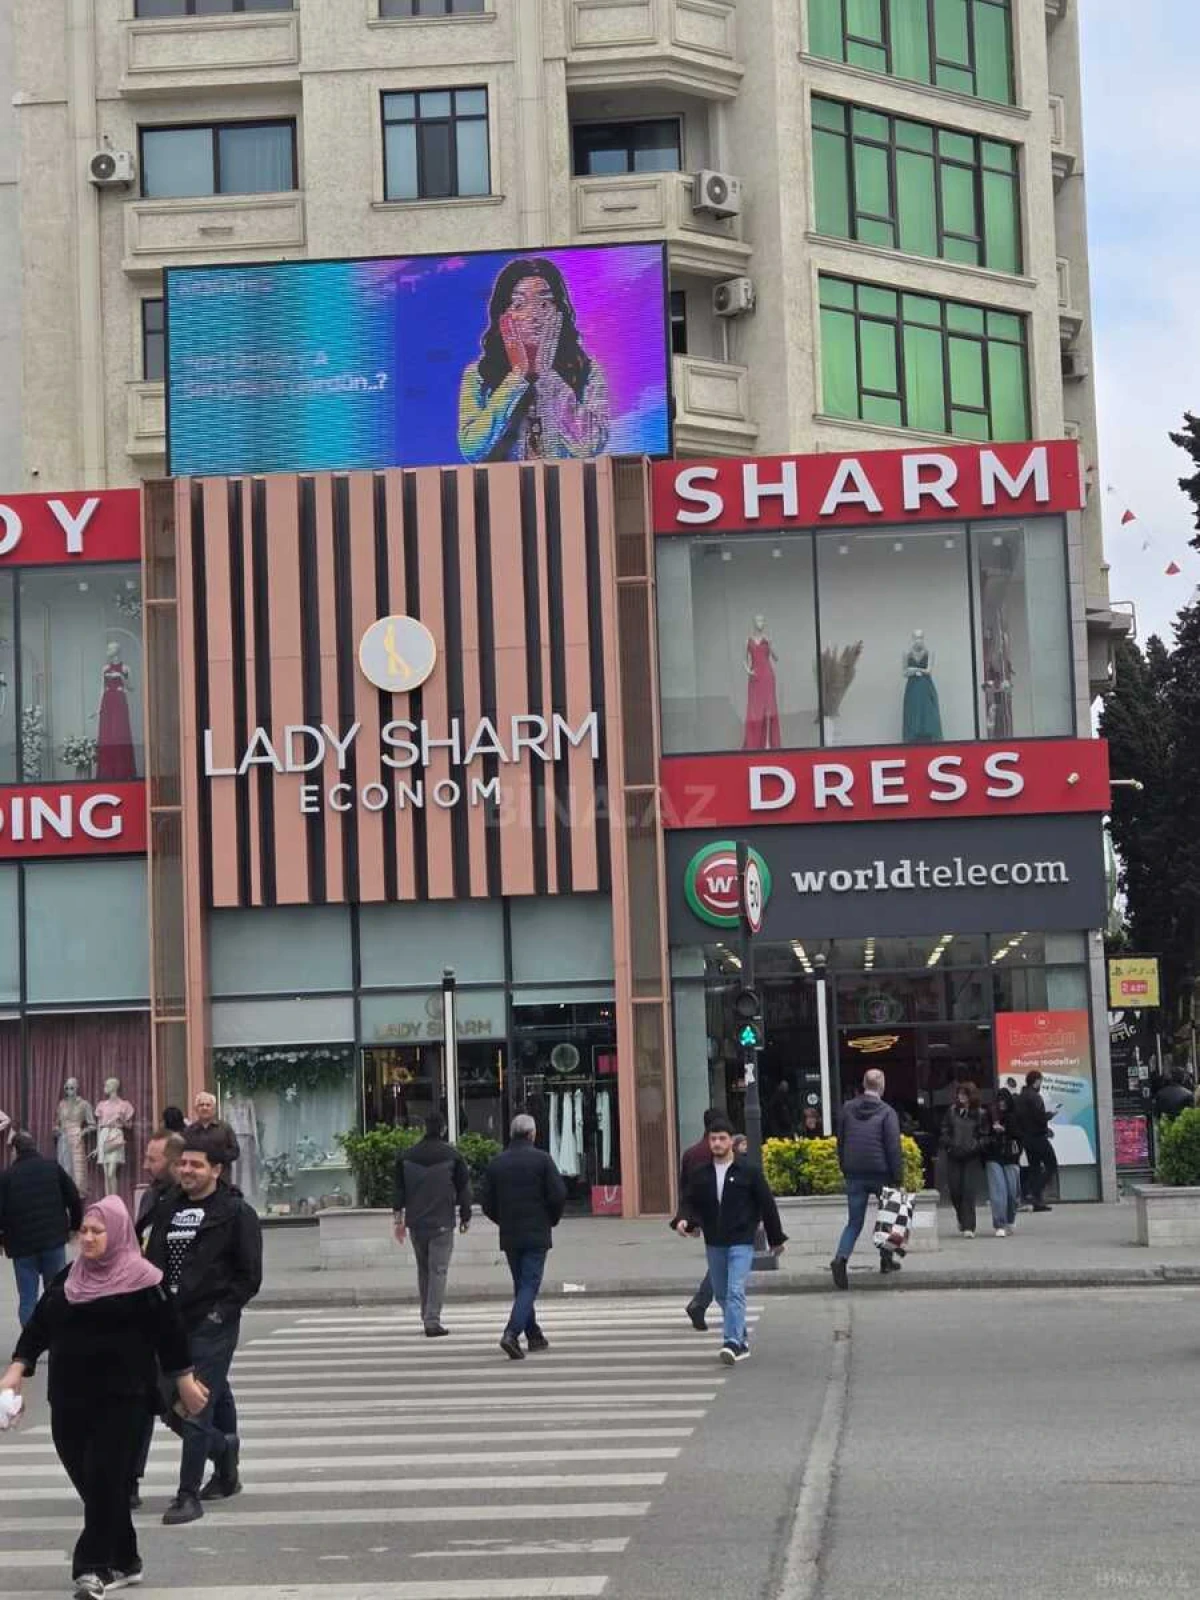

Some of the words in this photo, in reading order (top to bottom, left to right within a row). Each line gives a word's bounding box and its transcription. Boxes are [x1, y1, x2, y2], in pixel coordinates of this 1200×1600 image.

[675, 446, 1050, 524] SHARM
[204, 721, 361, 776] LADY
[381, 712, 599, 768] SHARM
[300, 776, 500, 814] ECONOM
[749, 751, 1025, 810] DRESS
[0, 793, 122, 840] ING
[791, 858, 1069, 893] worldtelecom
